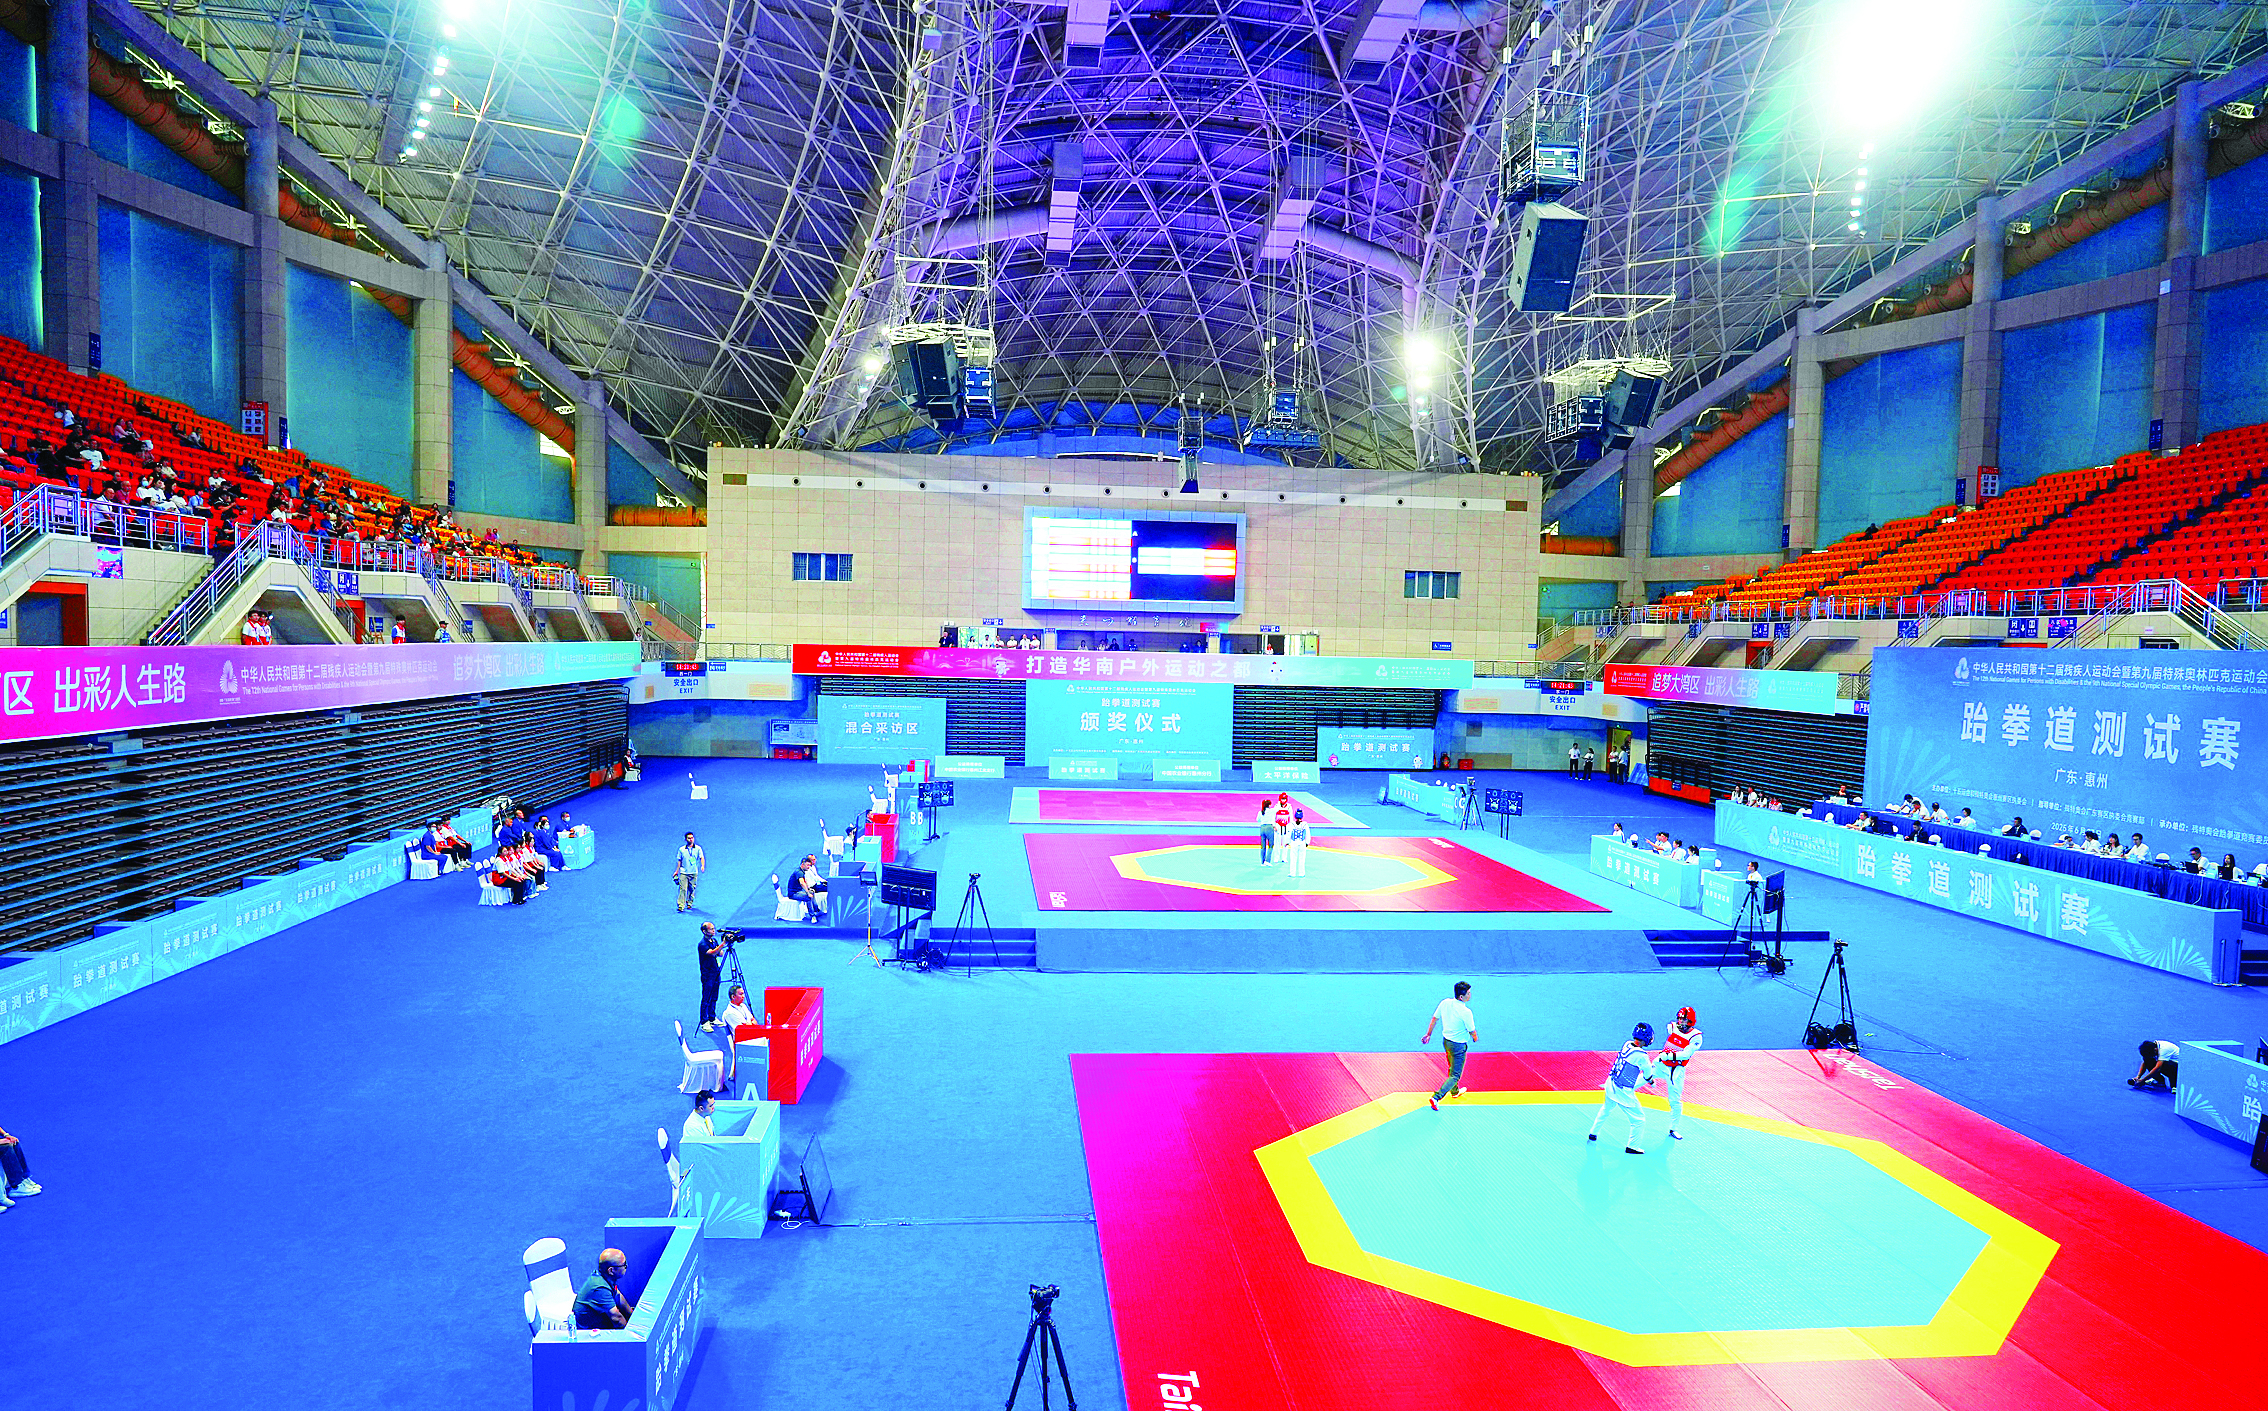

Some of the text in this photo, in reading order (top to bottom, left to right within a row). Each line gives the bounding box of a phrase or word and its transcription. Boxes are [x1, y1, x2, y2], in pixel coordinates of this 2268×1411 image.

[454, 654, 501, 681] 追梦大湾区
[506, 653, 544, 678] 出彩人生路
[1026, 656, 1250, 678] 打造华南户外运动之都
[1973, 662, 2268, 684] 中华人民共和国第十二届残疾人运动会暨第九届特殊奥林匹克运动会
[4, 663, 186, 716] 区 出彩人生路
[1652, 672, 1700, 694] 追梦大湾区
[1704, 675, 1760, 699] 出彩人生路
[2140, 682, 2160, 690] Olympic
[1102, 698, 1161, 708] 跆拳道测试赛
[846, 722, 918, 734] 混合采访区
[1080, 712, 1181, 734] 颁奖仪式
[1342, 742, 1410, 752] 跆拳道测试赛
[1960, 702, 2241, 770] 跆拳道测试赛
[2054, 768, 2108, 789] 广东·惠州
[1857, 844, 2089, 935] 跆拳道测试赛
[74, 952, 139, 988] 跆拳道测试赛
[742, 1083, 760, 1100] A
